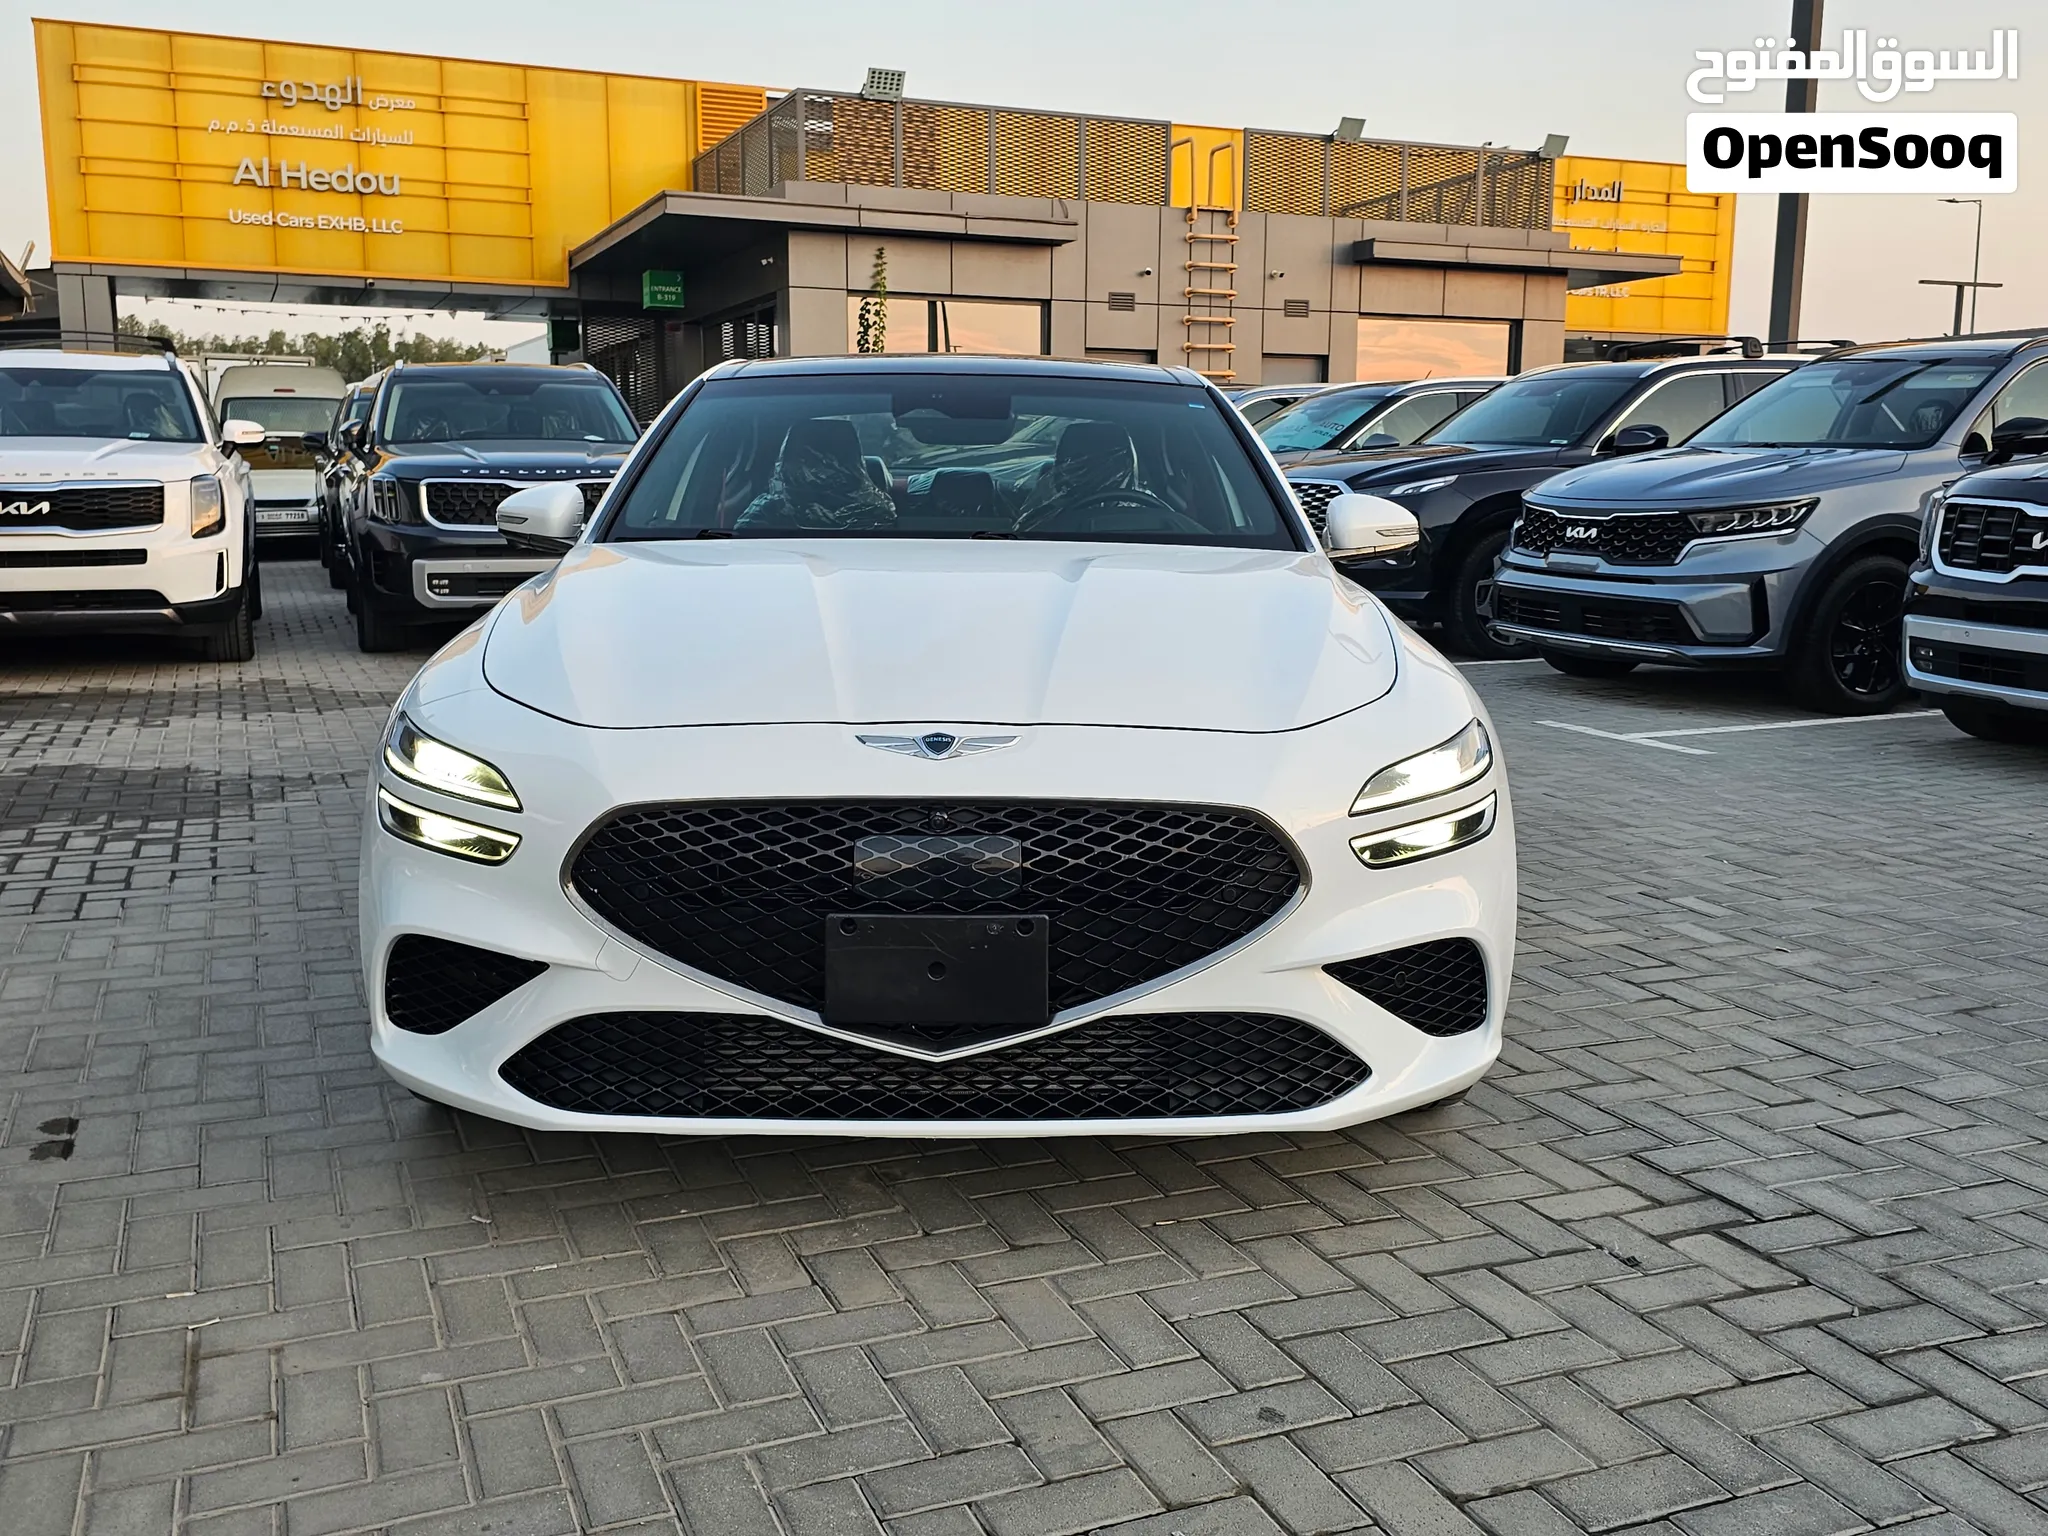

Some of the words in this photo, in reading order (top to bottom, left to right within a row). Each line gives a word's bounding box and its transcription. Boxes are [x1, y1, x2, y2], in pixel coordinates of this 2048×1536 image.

[261, 76, 363, 111] الهدوء
[369, 95, 416, 112] معرض
[261, 119, 344, 140] المستعملة
[350, 128, 414, 146] للسيارات
[233, 157, 270, 187] Al
[280, 160, 400, 195] Hedou
[228, 208, 273, 225] Used
[276, 212, 314, 229] Cars
[318, 216, 369, 233] EXHB.
[372, 218, 404, 235] LLC
[650, 285, 682, 293] ENTRANCE
[1566, 526, 1598, 539] KIA
